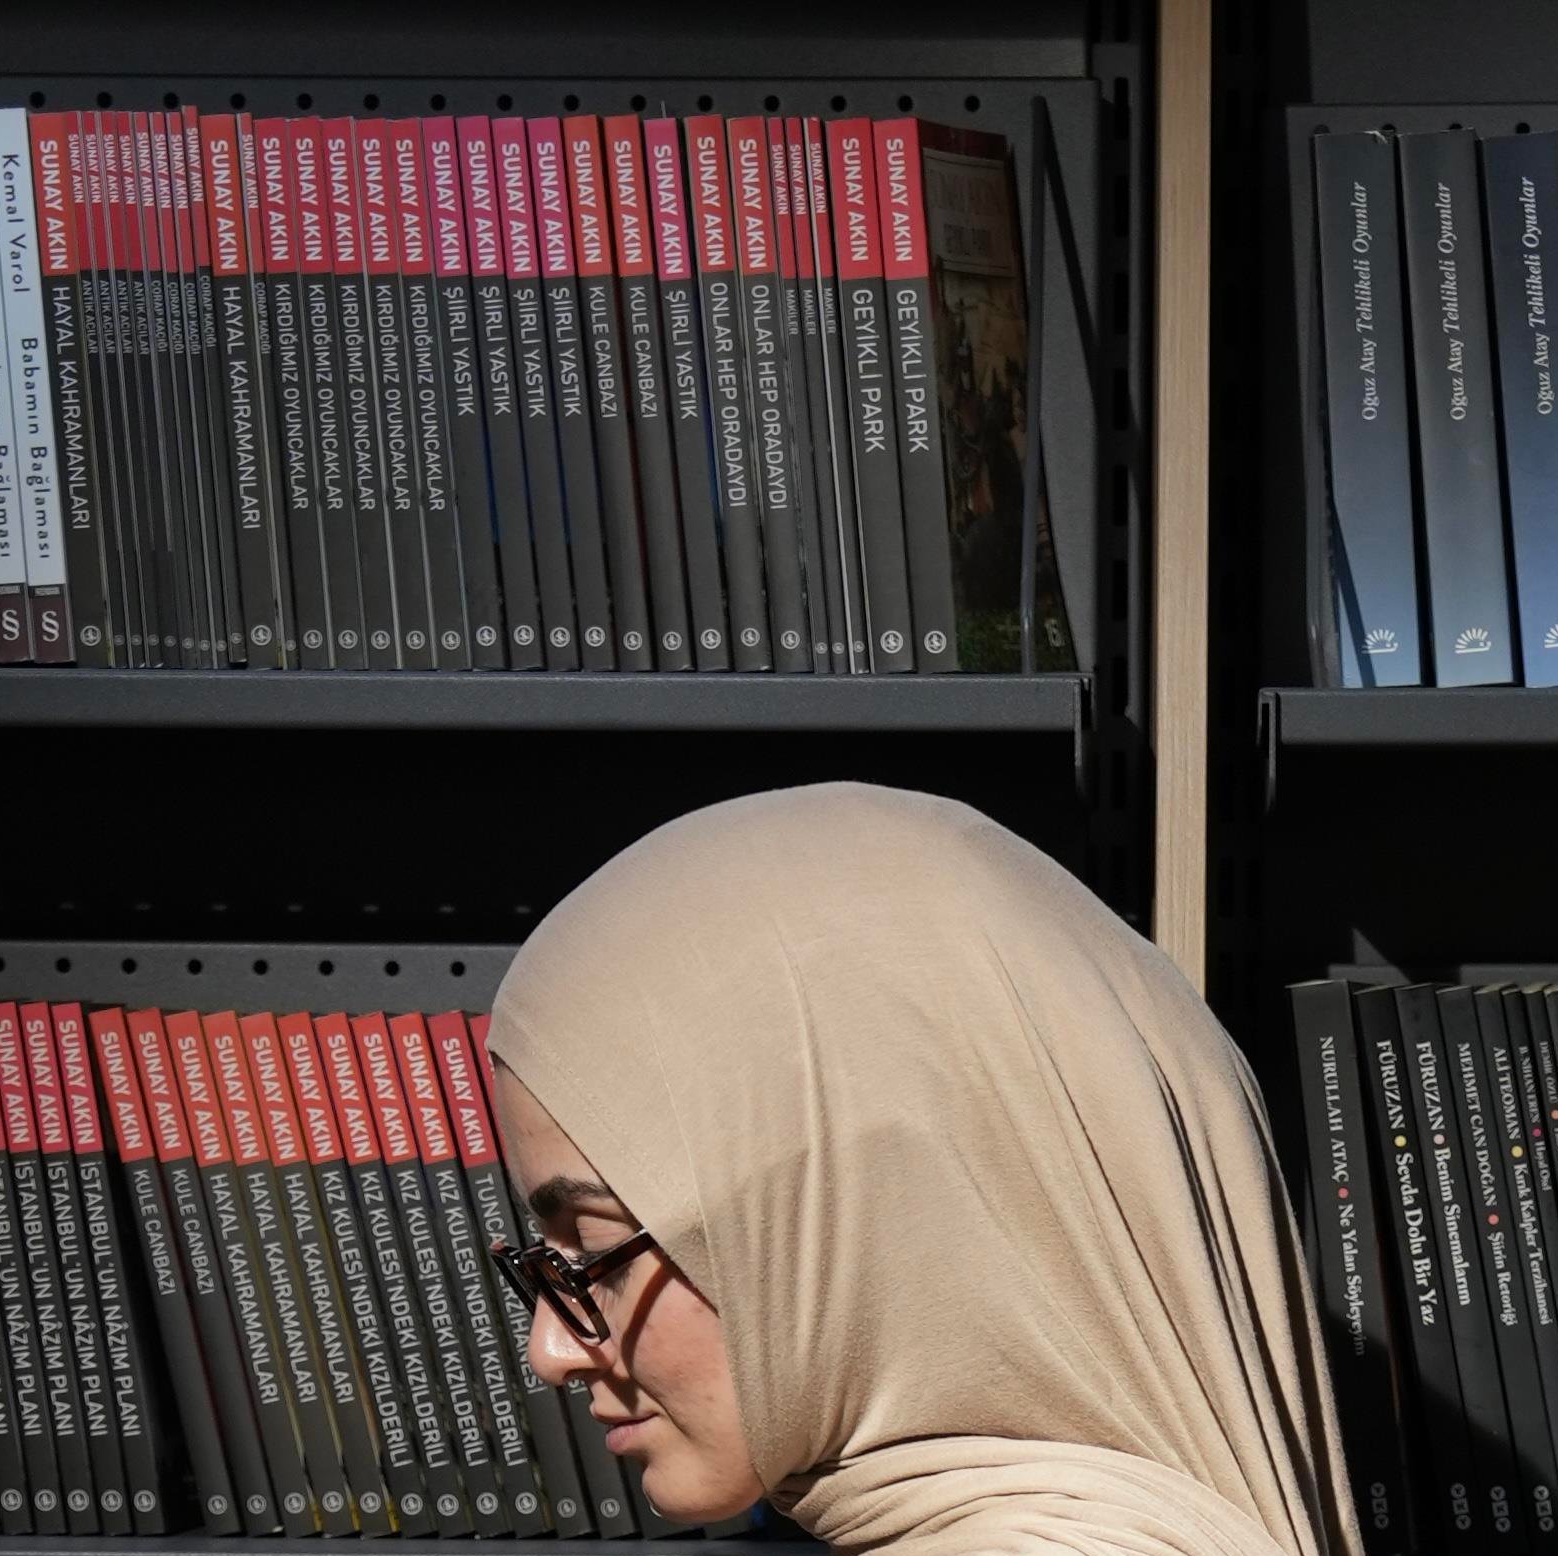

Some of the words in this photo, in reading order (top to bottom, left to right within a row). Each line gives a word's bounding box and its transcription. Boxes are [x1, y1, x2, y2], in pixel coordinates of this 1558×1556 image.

[210, 139, 231, 208] SUNAY
[216, 216, 238, 270] AKIN
[1351, 182, 1370, 253] Oyunlar
[222, 286, 241, 356] HAYAL
[1351, 258, 1373, 337] Tehlikeli
[275, 282, 299, 384] KIRDIĞIMIZ
[851, 288, 882, 379] GEYİKLİ
[1356, 341, 1377, 377] Atay
[861, 387, 886, 454] PARK
[1362, 381, 1380, 422] Oğuz
[230, 360, 261, 530] KAHRAMANLARI
[282, 388, 308, 510] OYUNCAKLAR
[1376, 1039, 1405, 1130] FÜRUZAN
[1415, 1041, 1446, 1131] FÜRUZAN
[1394, 1152, 1416, 1203] Sevda
[1437, 1147, 1457, 1201] Benim
[1402, 1207, 1423, 1245] Dolu
[1443, 1204, 1471, 1306] Sinemalarım
[1408, 1250, 1428, 1281] Bir
[1414, 1286, 1437, 1326] Yaz
